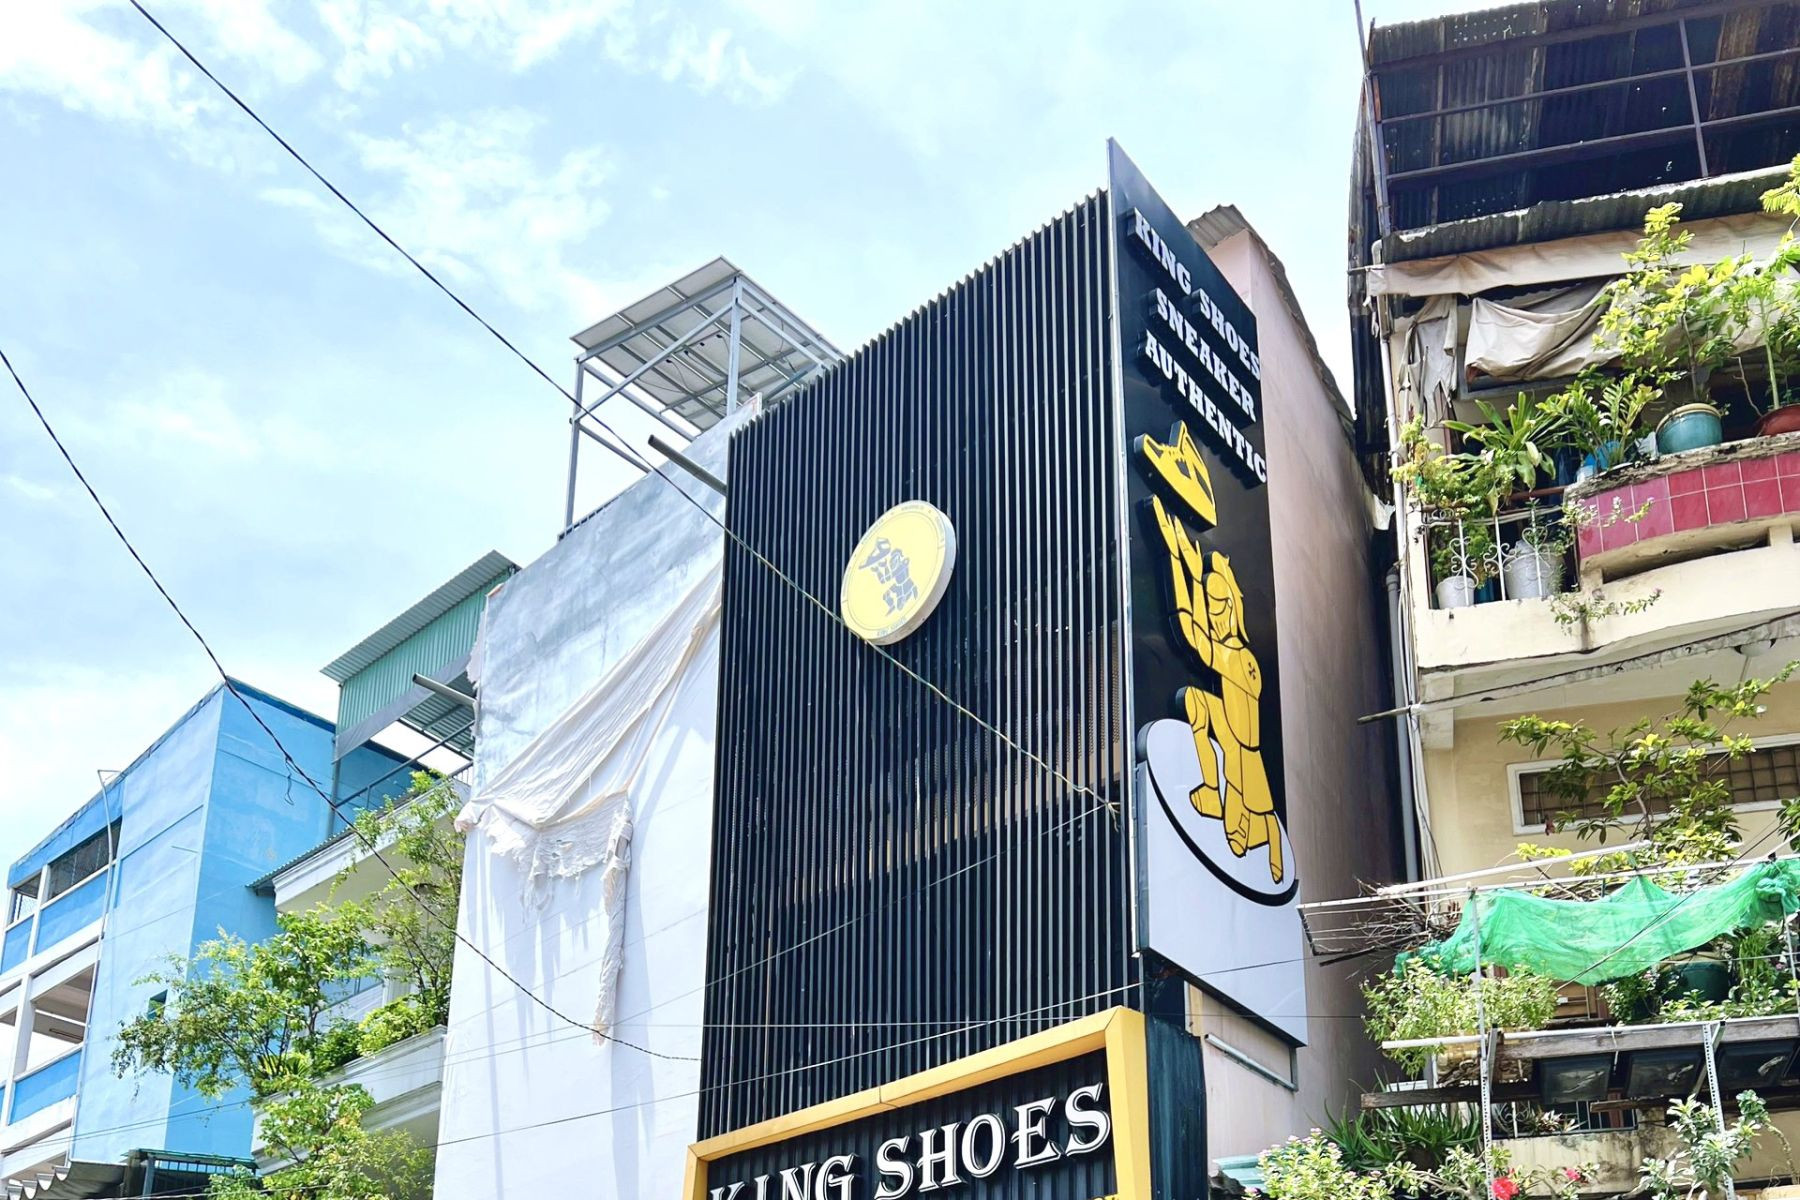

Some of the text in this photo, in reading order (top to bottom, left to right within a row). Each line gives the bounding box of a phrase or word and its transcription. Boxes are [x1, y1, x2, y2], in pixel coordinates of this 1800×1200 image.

[1133, 206, 1261, 382] KING SHOES
[1155, 287, 1257, 423] SNEAKER
[1145, 328, 1268, 484] AUTHENTIC
